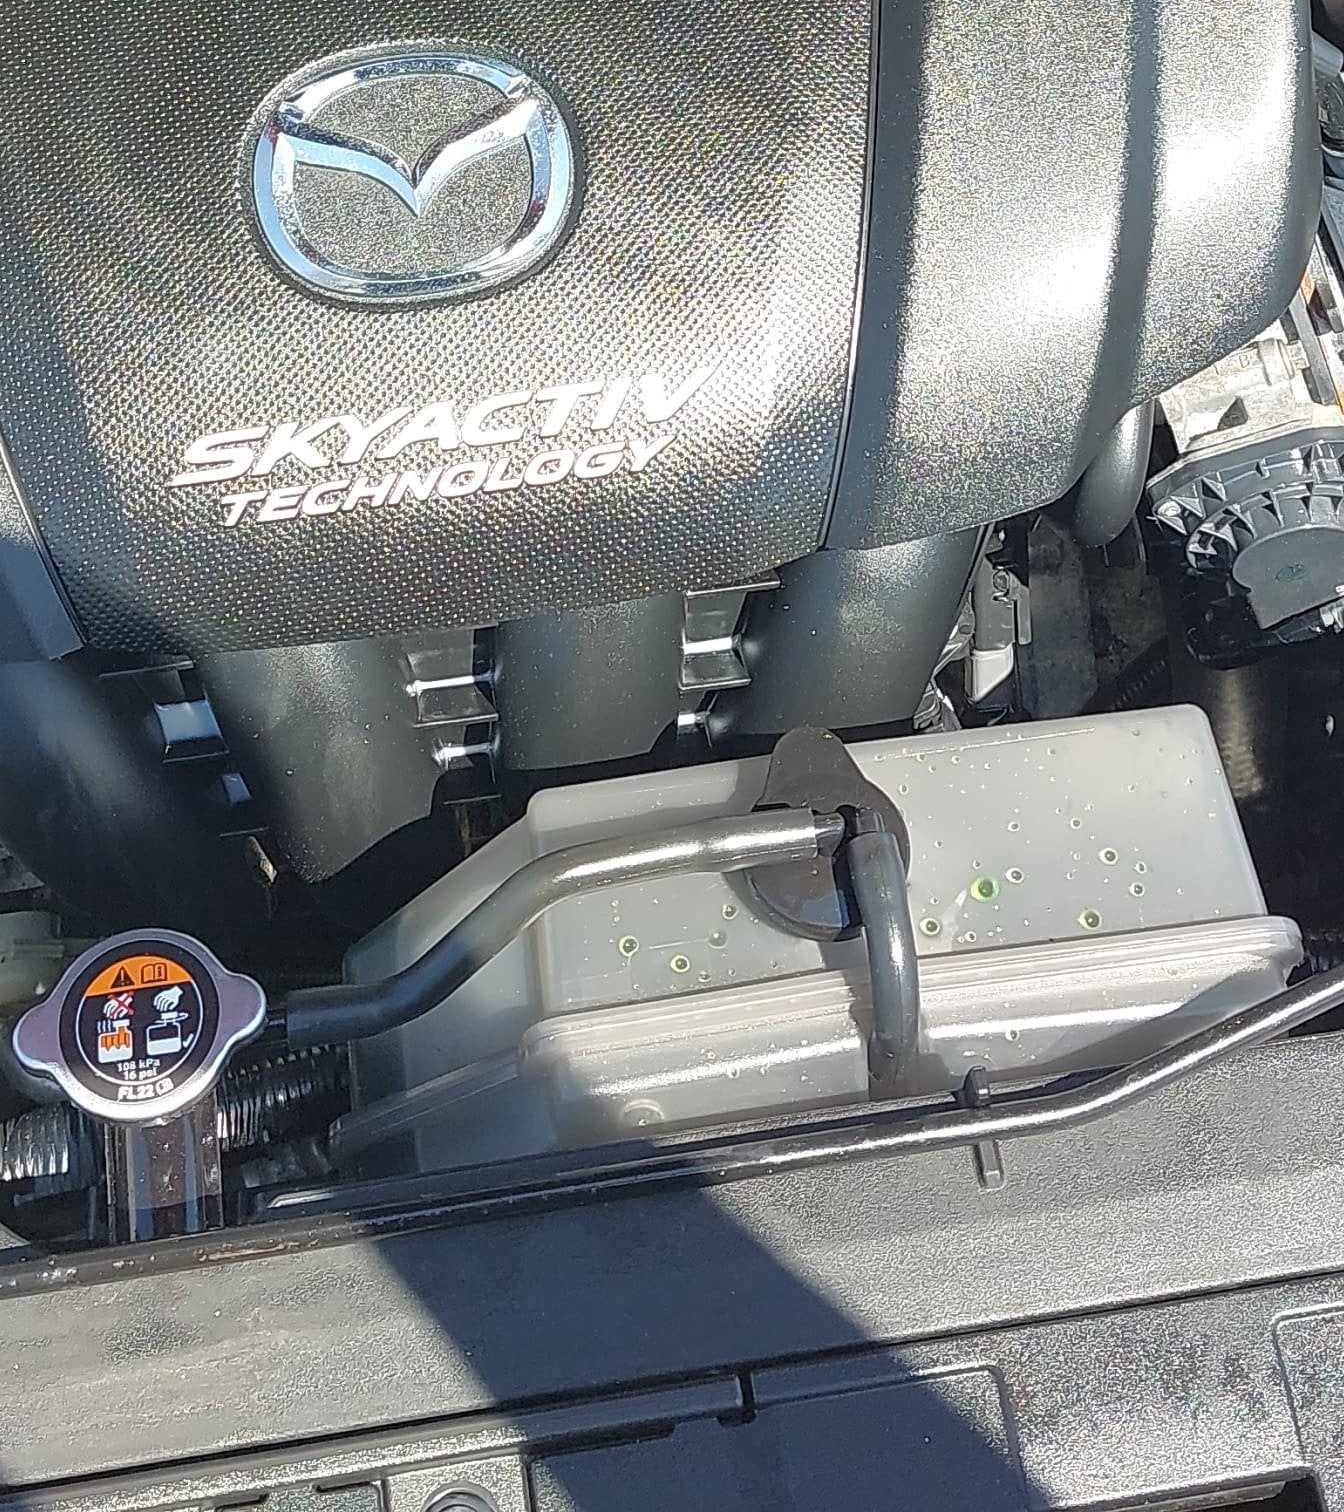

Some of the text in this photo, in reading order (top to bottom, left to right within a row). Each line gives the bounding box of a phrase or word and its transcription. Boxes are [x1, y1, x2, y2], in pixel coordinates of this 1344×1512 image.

[169, 362, 719, 487] SKYACTIV
[221, 435, 676, 527] TECHNOLOGY
[116, 1058, 161, 1072] 108 kPa
[124, 1067, 158, 1081] 16 psi
[118, 1084, 155, 1100] FL22
